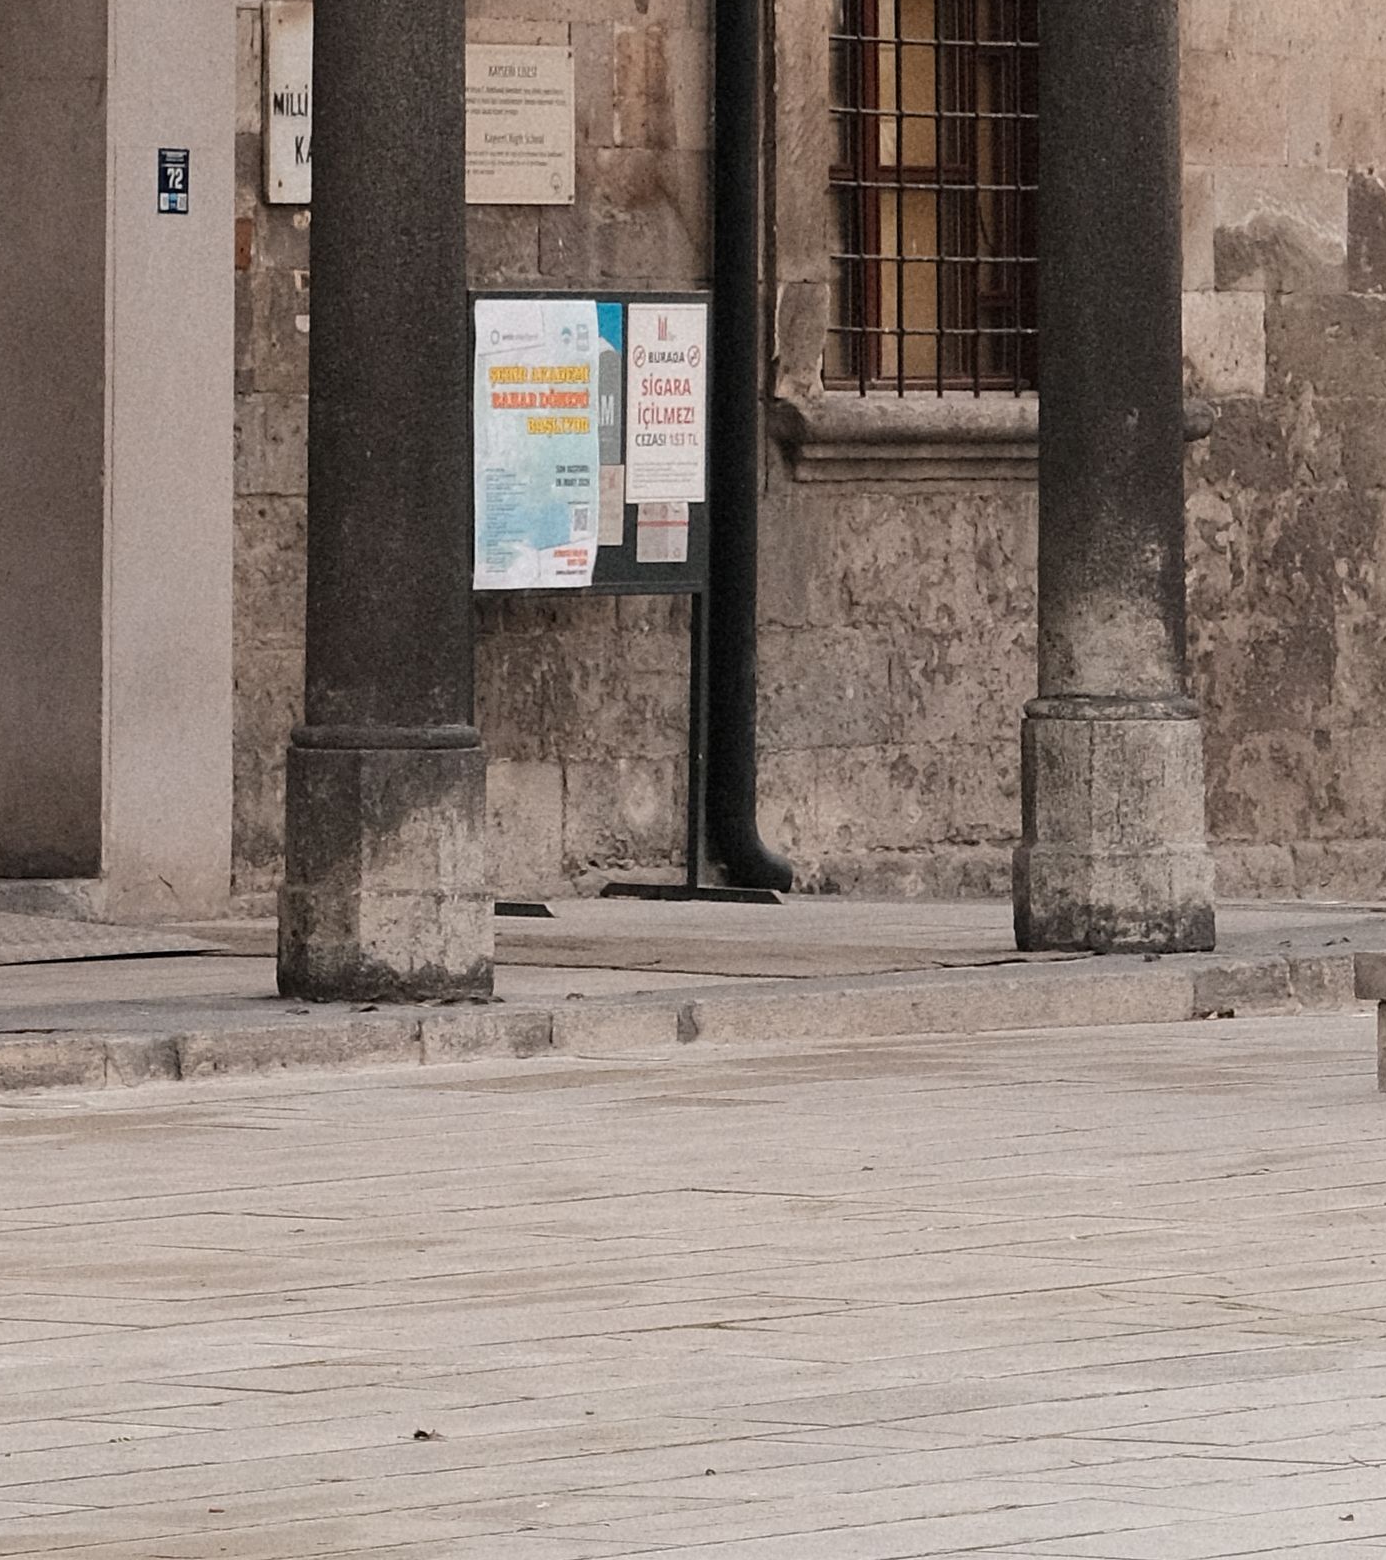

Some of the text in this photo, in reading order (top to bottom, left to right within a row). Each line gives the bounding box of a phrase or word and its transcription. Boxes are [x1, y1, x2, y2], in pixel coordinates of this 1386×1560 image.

[166, 167, 184, 190] 72
[648, 351, 685, 364] BURADA
[641, 372, 692, 397] SİGARA
[637, 401, 695, 430] İÇİLMEZ!
[635, 432, 667, 447] CEZASI
[687, 432, 699, 447] TL
